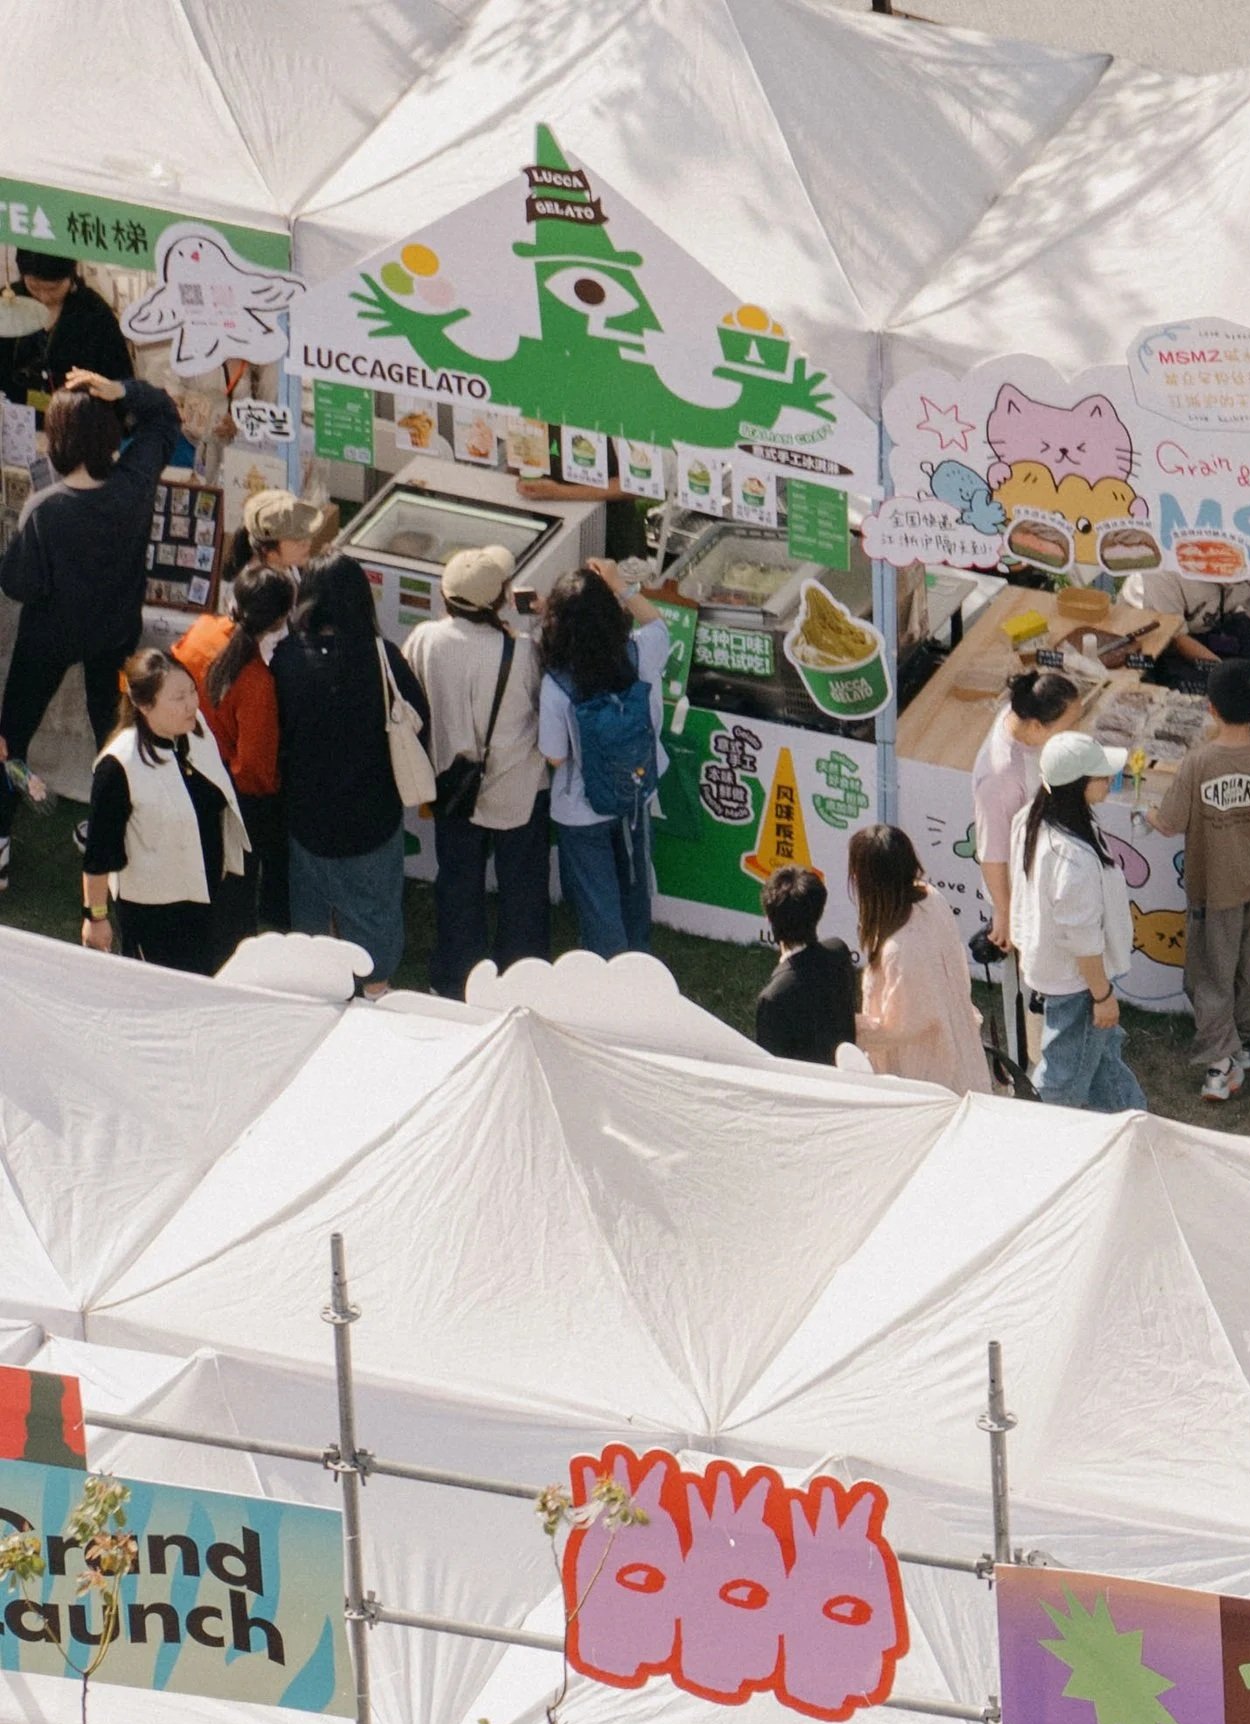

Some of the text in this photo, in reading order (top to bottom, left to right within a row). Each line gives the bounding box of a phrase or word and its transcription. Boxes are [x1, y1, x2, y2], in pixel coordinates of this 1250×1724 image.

[531, 169, 585, 188] LUCCA
[535, 200, 595, 220] GELATO
[303, 345, 487, 399] LUCCAGELATO
[1156, 441, 1233, 477] Grain
[0, 1588, 286, 1667] aunch
